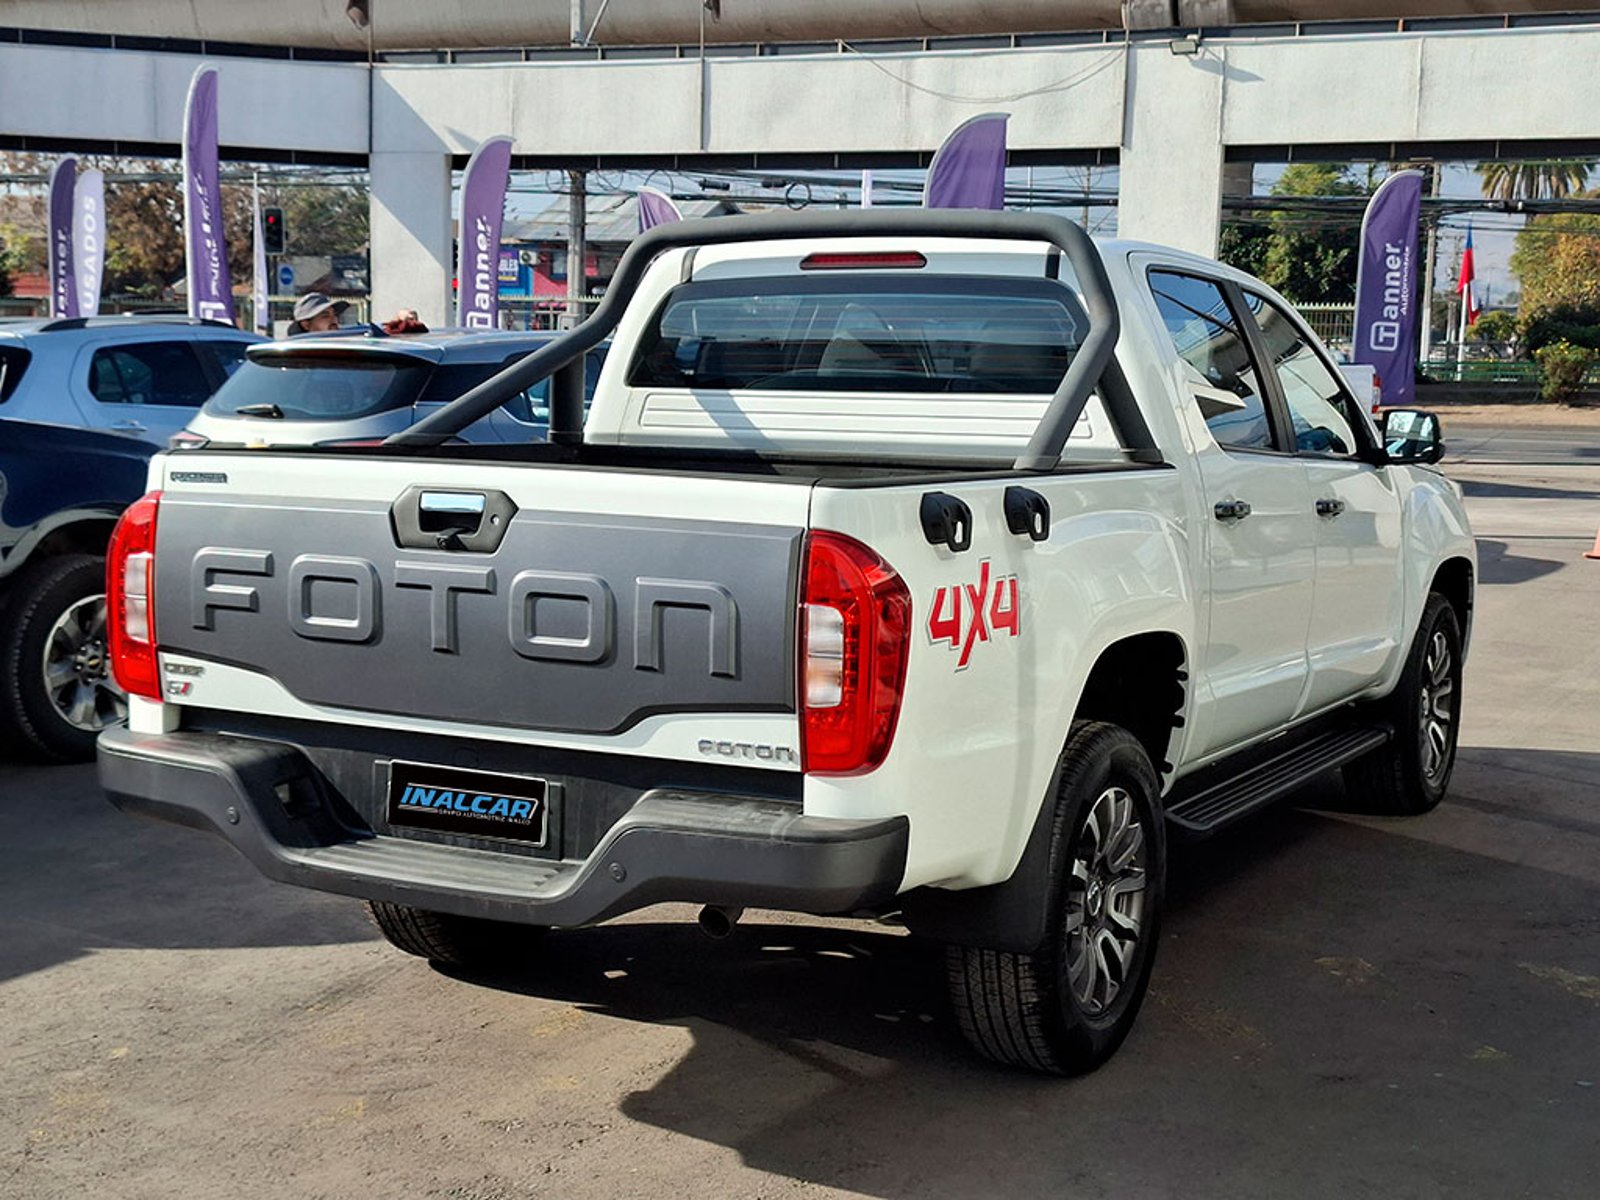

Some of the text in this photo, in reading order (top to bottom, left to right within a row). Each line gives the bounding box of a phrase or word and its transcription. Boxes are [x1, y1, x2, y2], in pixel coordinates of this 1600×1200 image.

[57, 229, 66, 318] anner
[83, 196, 97, 309] USADOS
[1370, 243, 1401, 351] Tanner
[191, 546, 737, 680] FOTON
[401, 787, 532, 819] INALCAR
